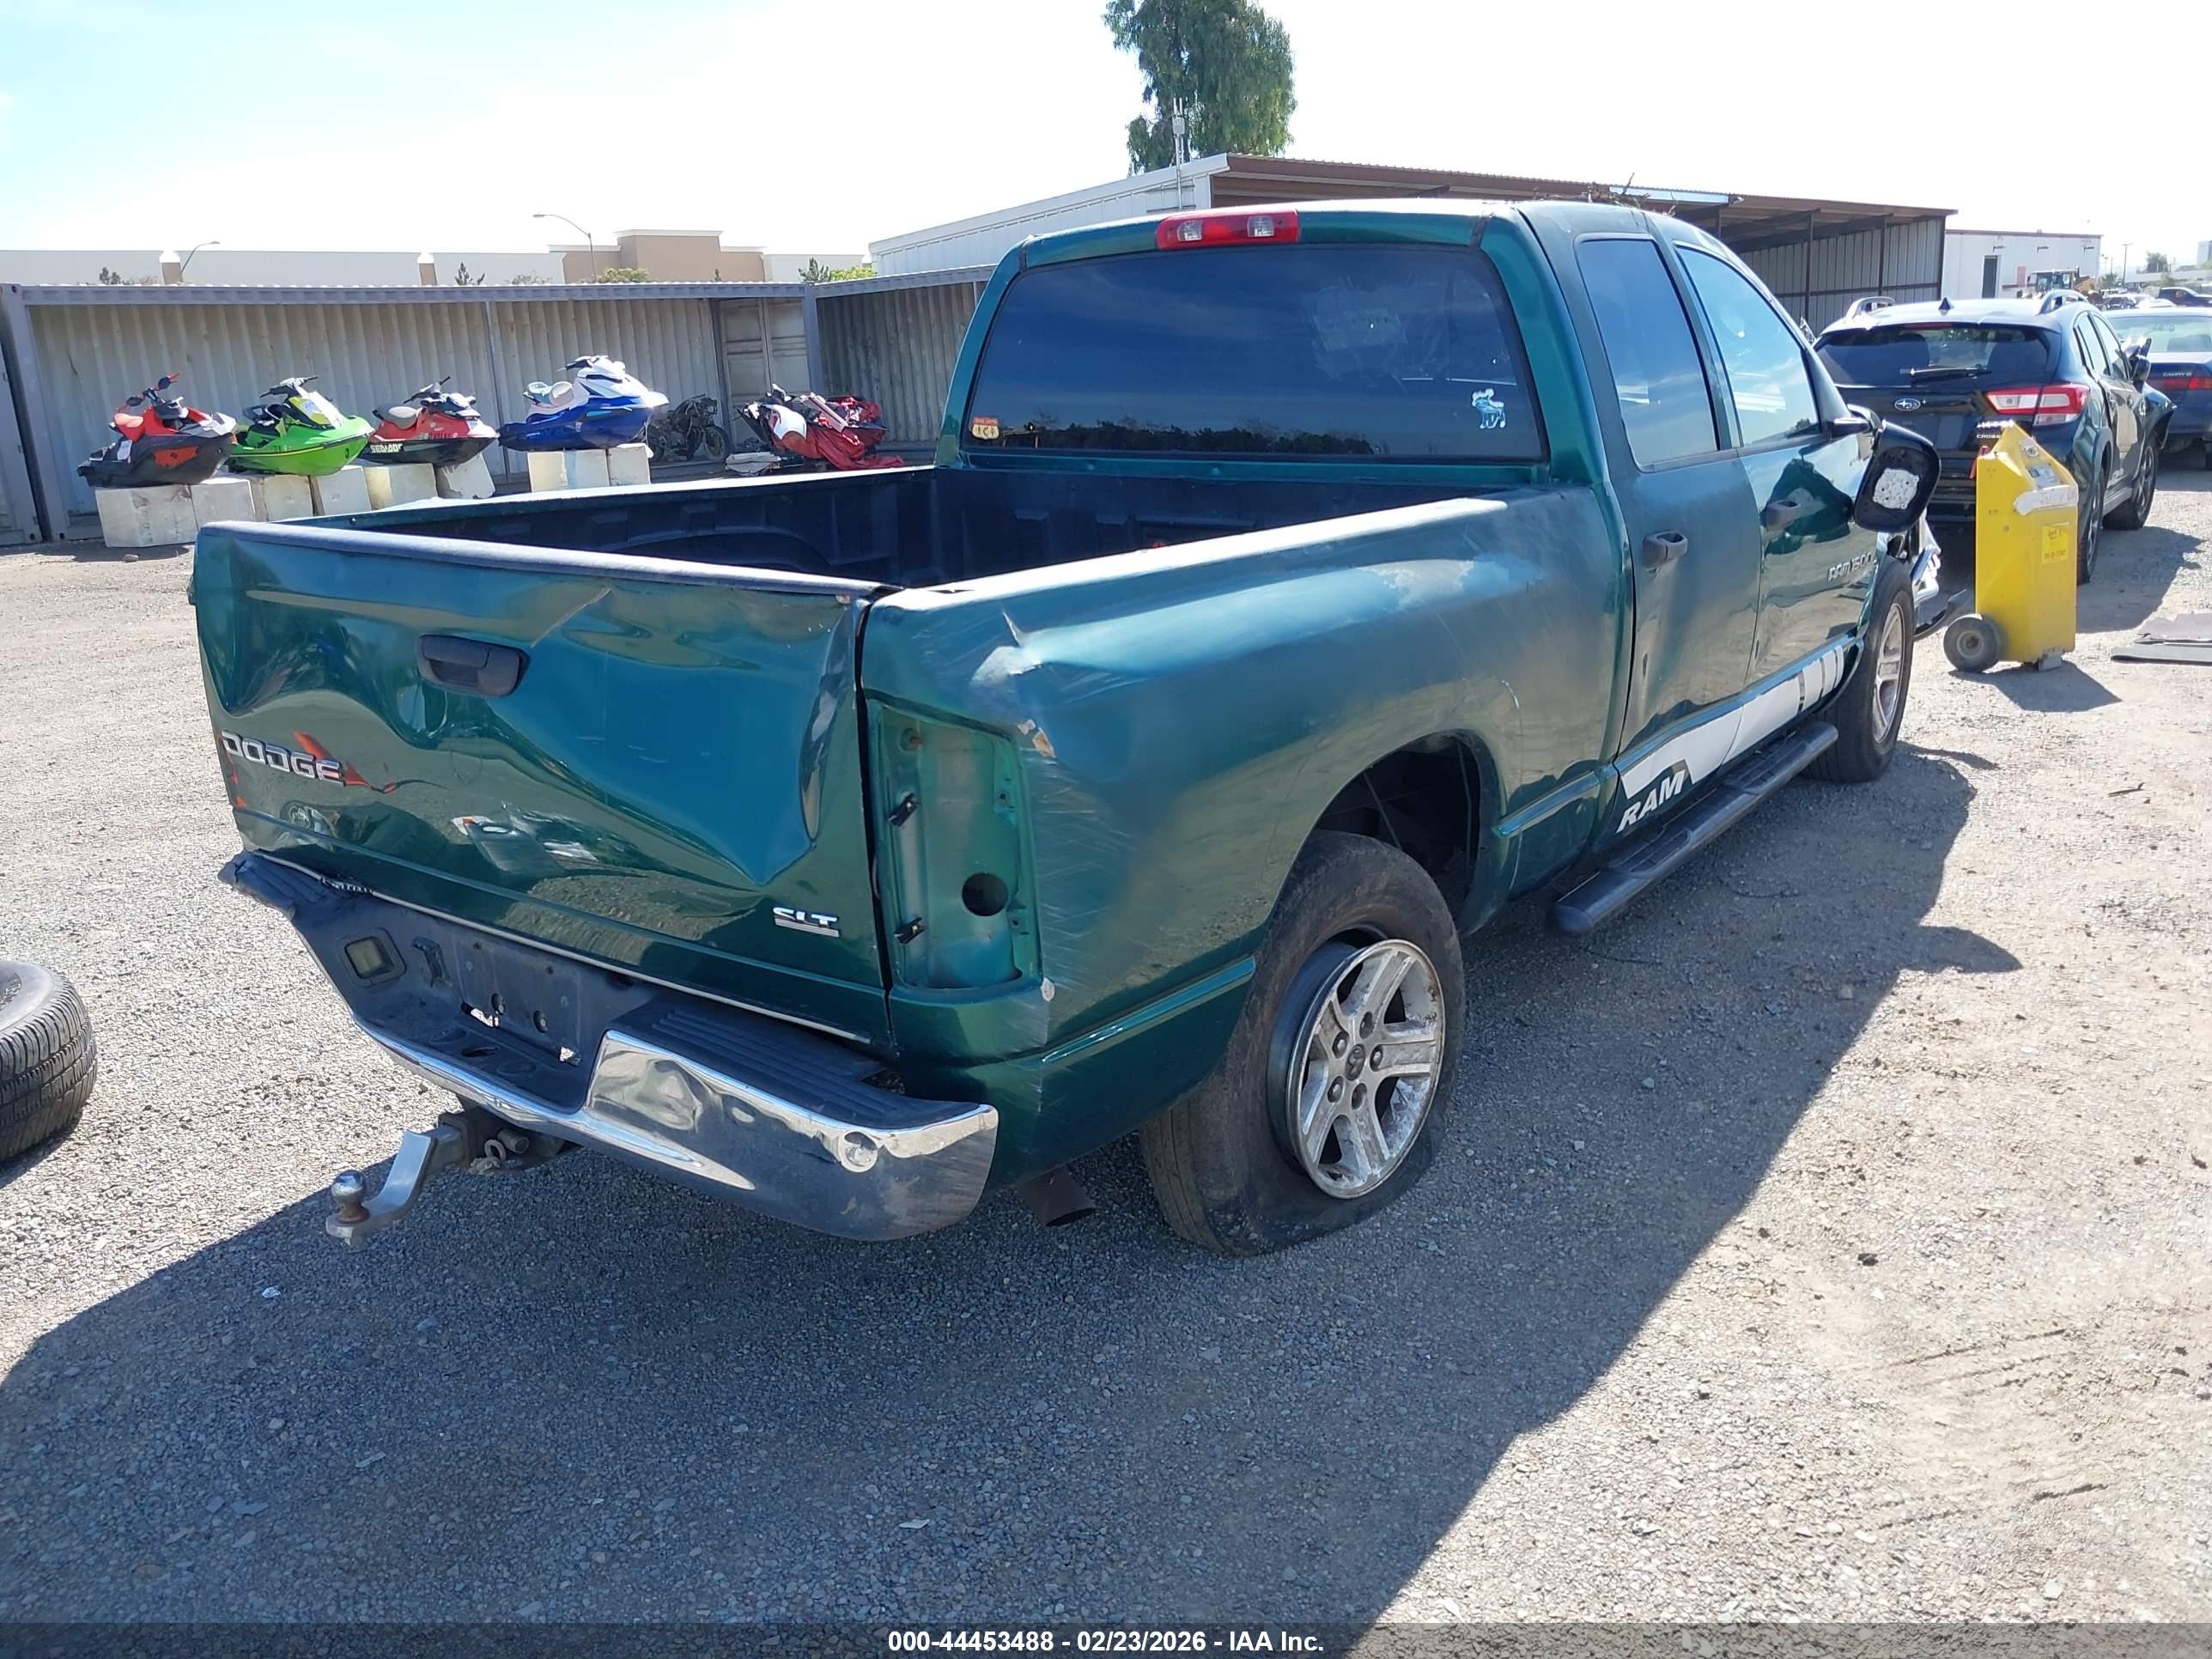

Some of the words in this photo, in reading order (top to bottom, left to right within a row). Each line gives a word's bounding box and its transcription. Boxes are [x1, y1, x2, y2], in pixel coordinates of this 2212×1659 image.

[1827, 562, 1850, 582] RAM
[1851, 551, 1872, 571] 1500
[221, 729, 345, 787] DODGE
[1615, 769, 1686, 835] RAM
[772, 906, 839, 927] SLT
